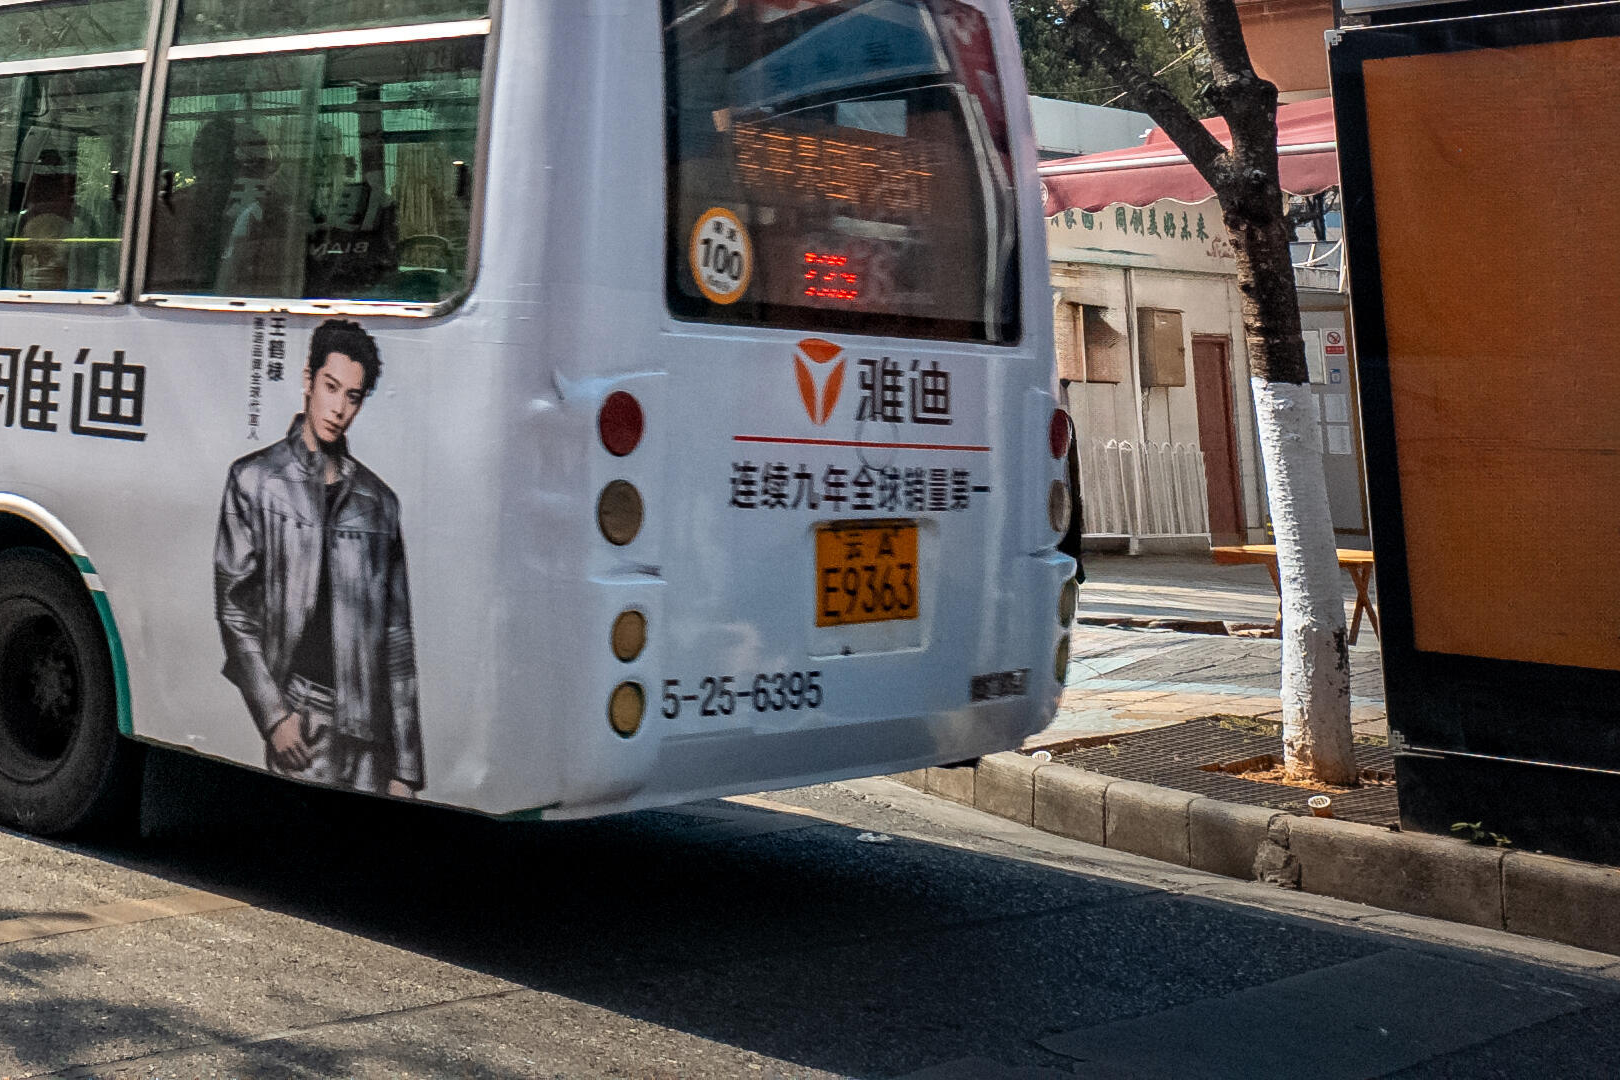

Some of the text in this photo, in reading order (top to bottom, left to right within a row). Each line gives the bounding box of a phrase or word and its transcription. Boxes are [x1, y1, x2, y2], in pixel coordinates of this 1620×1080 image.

[700, 237, 743, 281] 100
[854, 355, 953, 426] 雅迪
[729, 460, 991, 512] 连续九年全球销量第一
[823, 563, 915, 617] E9363
[661, 671, 824, 720] 5-25-6395
